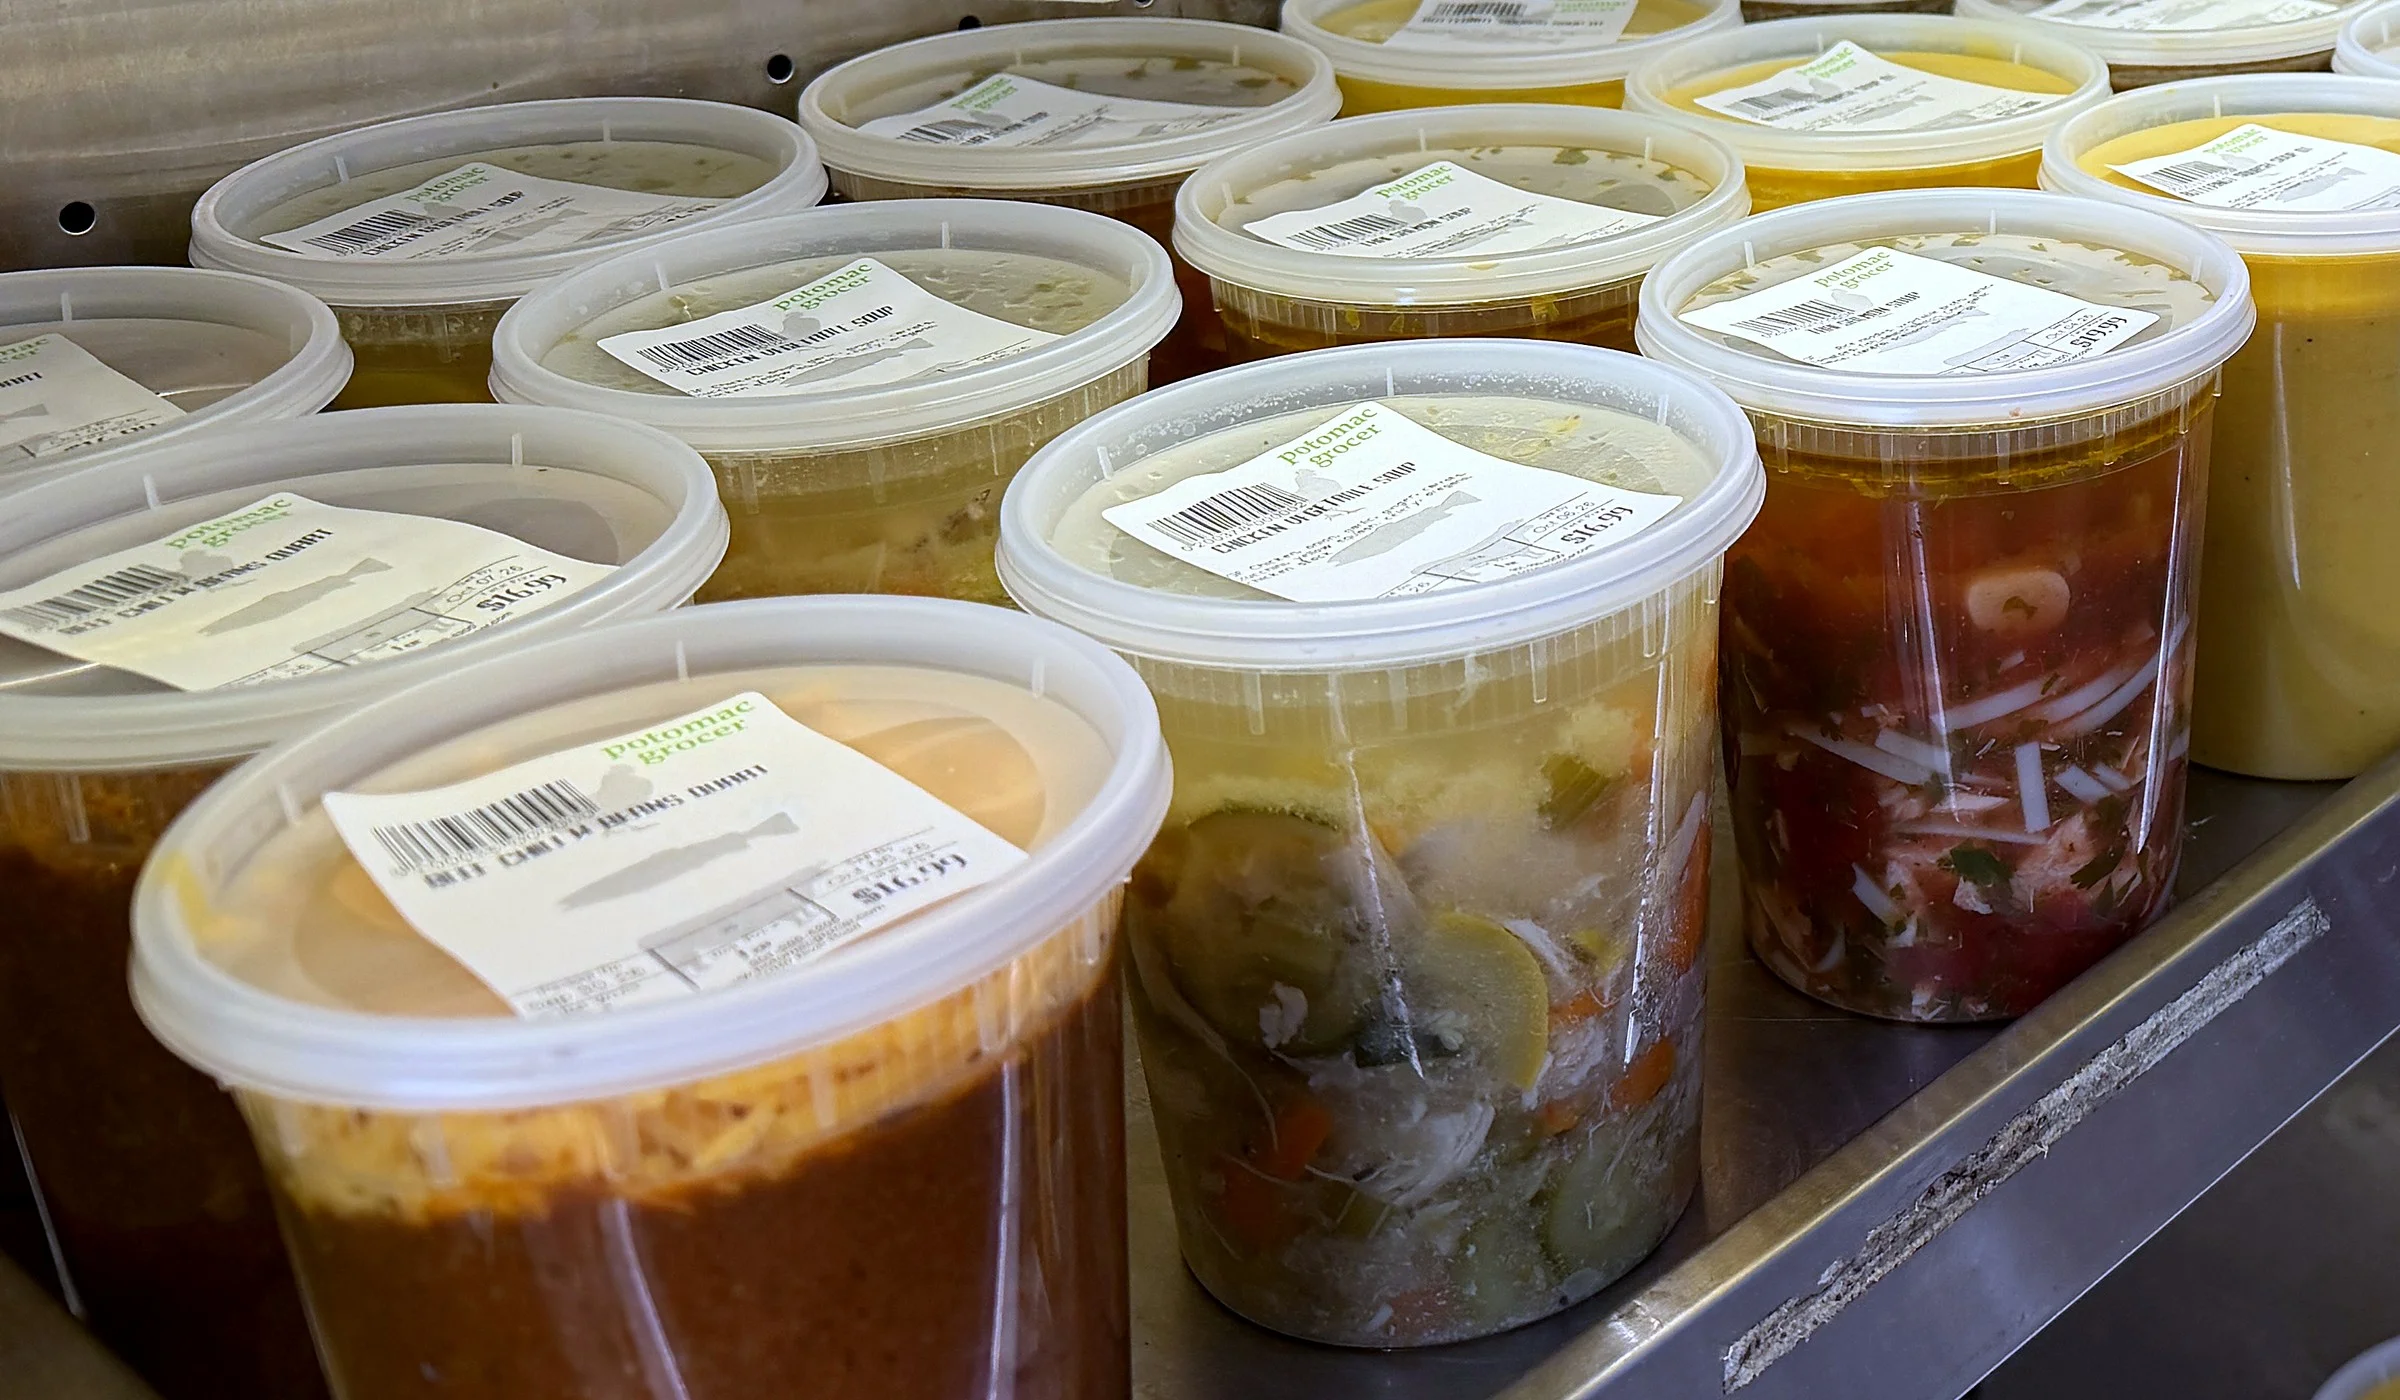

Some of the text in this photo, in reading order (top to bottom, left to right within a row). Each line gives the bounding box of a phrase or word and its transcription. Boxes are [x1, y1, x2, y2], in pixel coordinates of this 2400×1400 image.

[1375, 164, 1453, 199] potomac
[1400, 172, 1455, 201] grocer
[773, 263, 873, 312] potomac
[1813, 251, 1891, 288] potomac
[1840, 260, 1896, 290] grocer
[800, 273, 873, 311] grocer
[685, 353, 761, 376] CHICKEN
[851, 305, 894, 327] SOUP
[2070, 316, 2128, 349] $19.99
[1278, 408, 1378, 466] potomac
[1309, 423, 1382, 468] grocer
[165, 499, 293, 550] potomac
[1211, 461, 1417, 554] CHICKEN VEGETABLE SOUP
[1560, 506, 1634, 545] $16.99
[265, 527, 334, 561] QUART
[446, 565, 524, 603] Oct 07 26
[476, 574, 567, 612] $16.99
[602, 699, 756, 761] potomac
[637, 717, 749, 766] grocer
[599, 794, 686, 830] BEANS
[686, 763, 769, 798] QUART
[852, 854, 967, 904] $16.99
